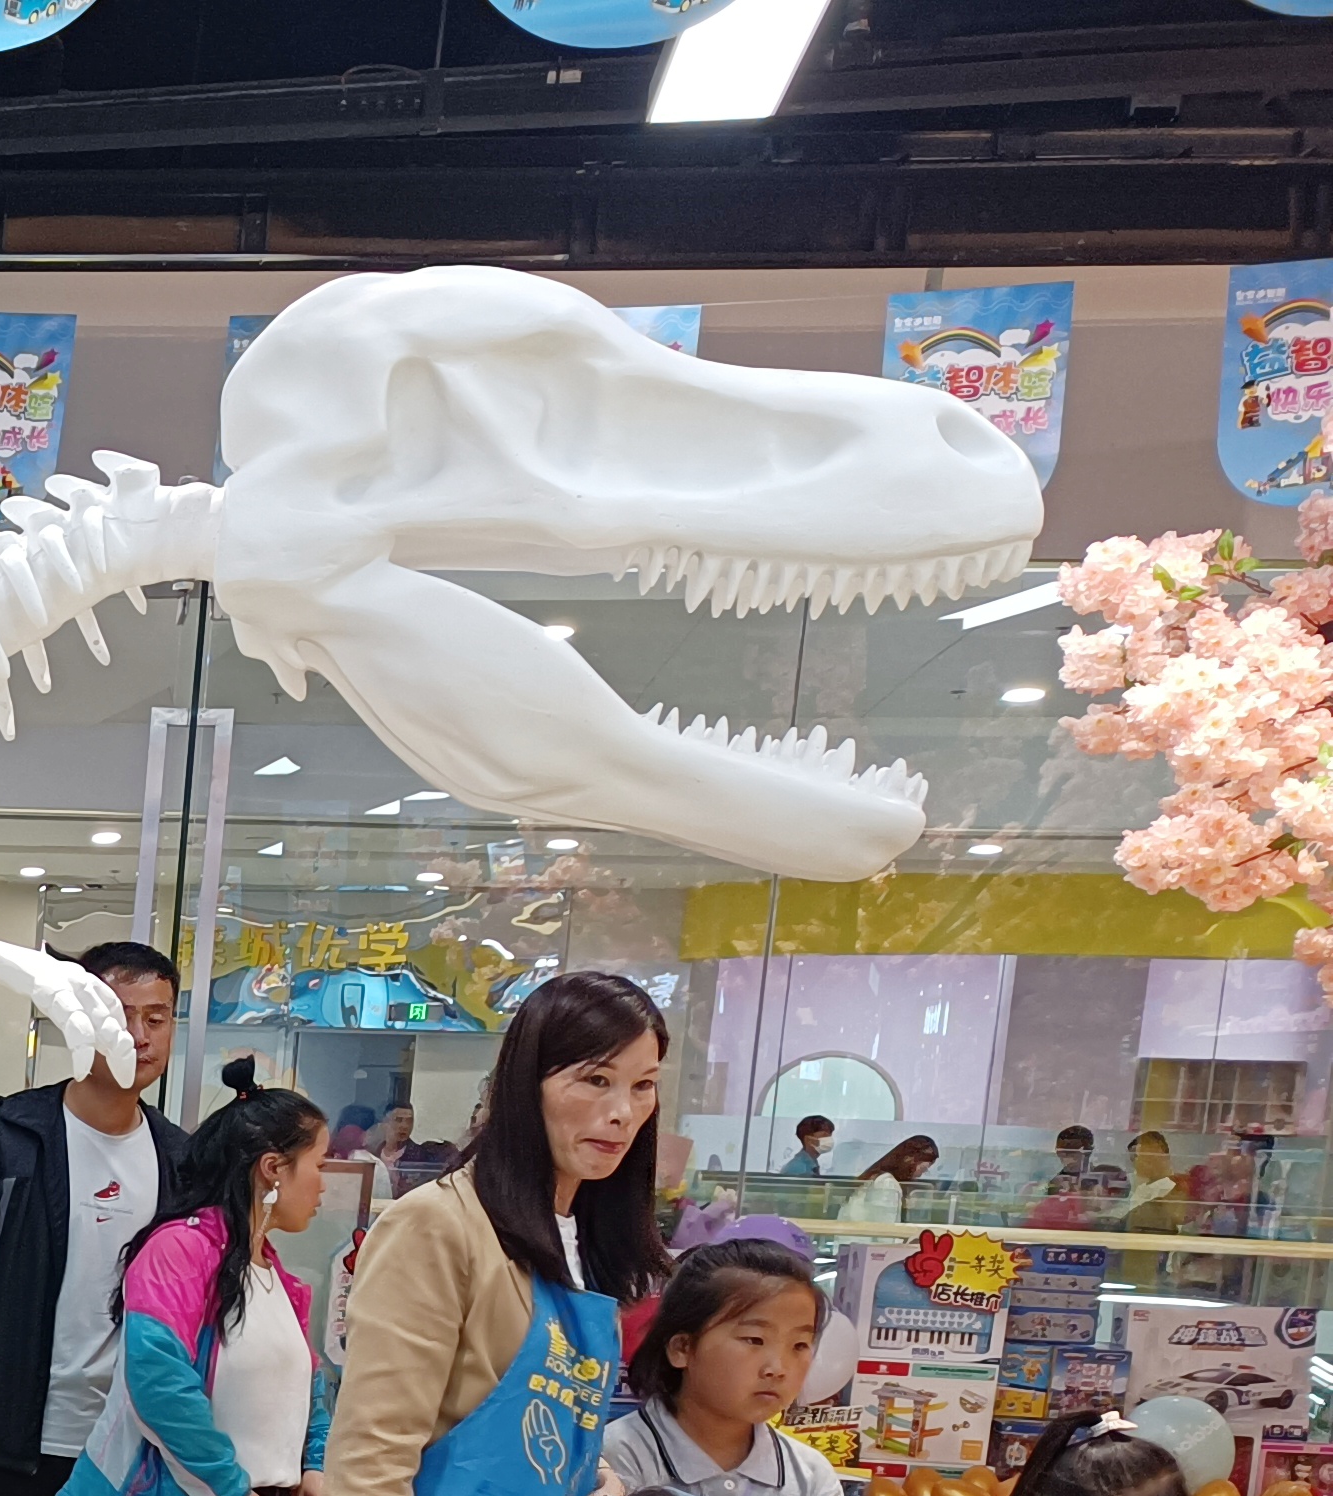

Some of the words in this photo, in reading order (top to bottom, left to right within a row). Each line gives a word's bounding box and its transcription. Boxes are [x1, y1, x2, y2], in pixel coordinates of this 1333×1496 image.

[1242, 337, 1333, 381] 益智
[955, 1253, 1008, 1280] 一等奖
[933, 1282, 1003, 1310] 店长推介
